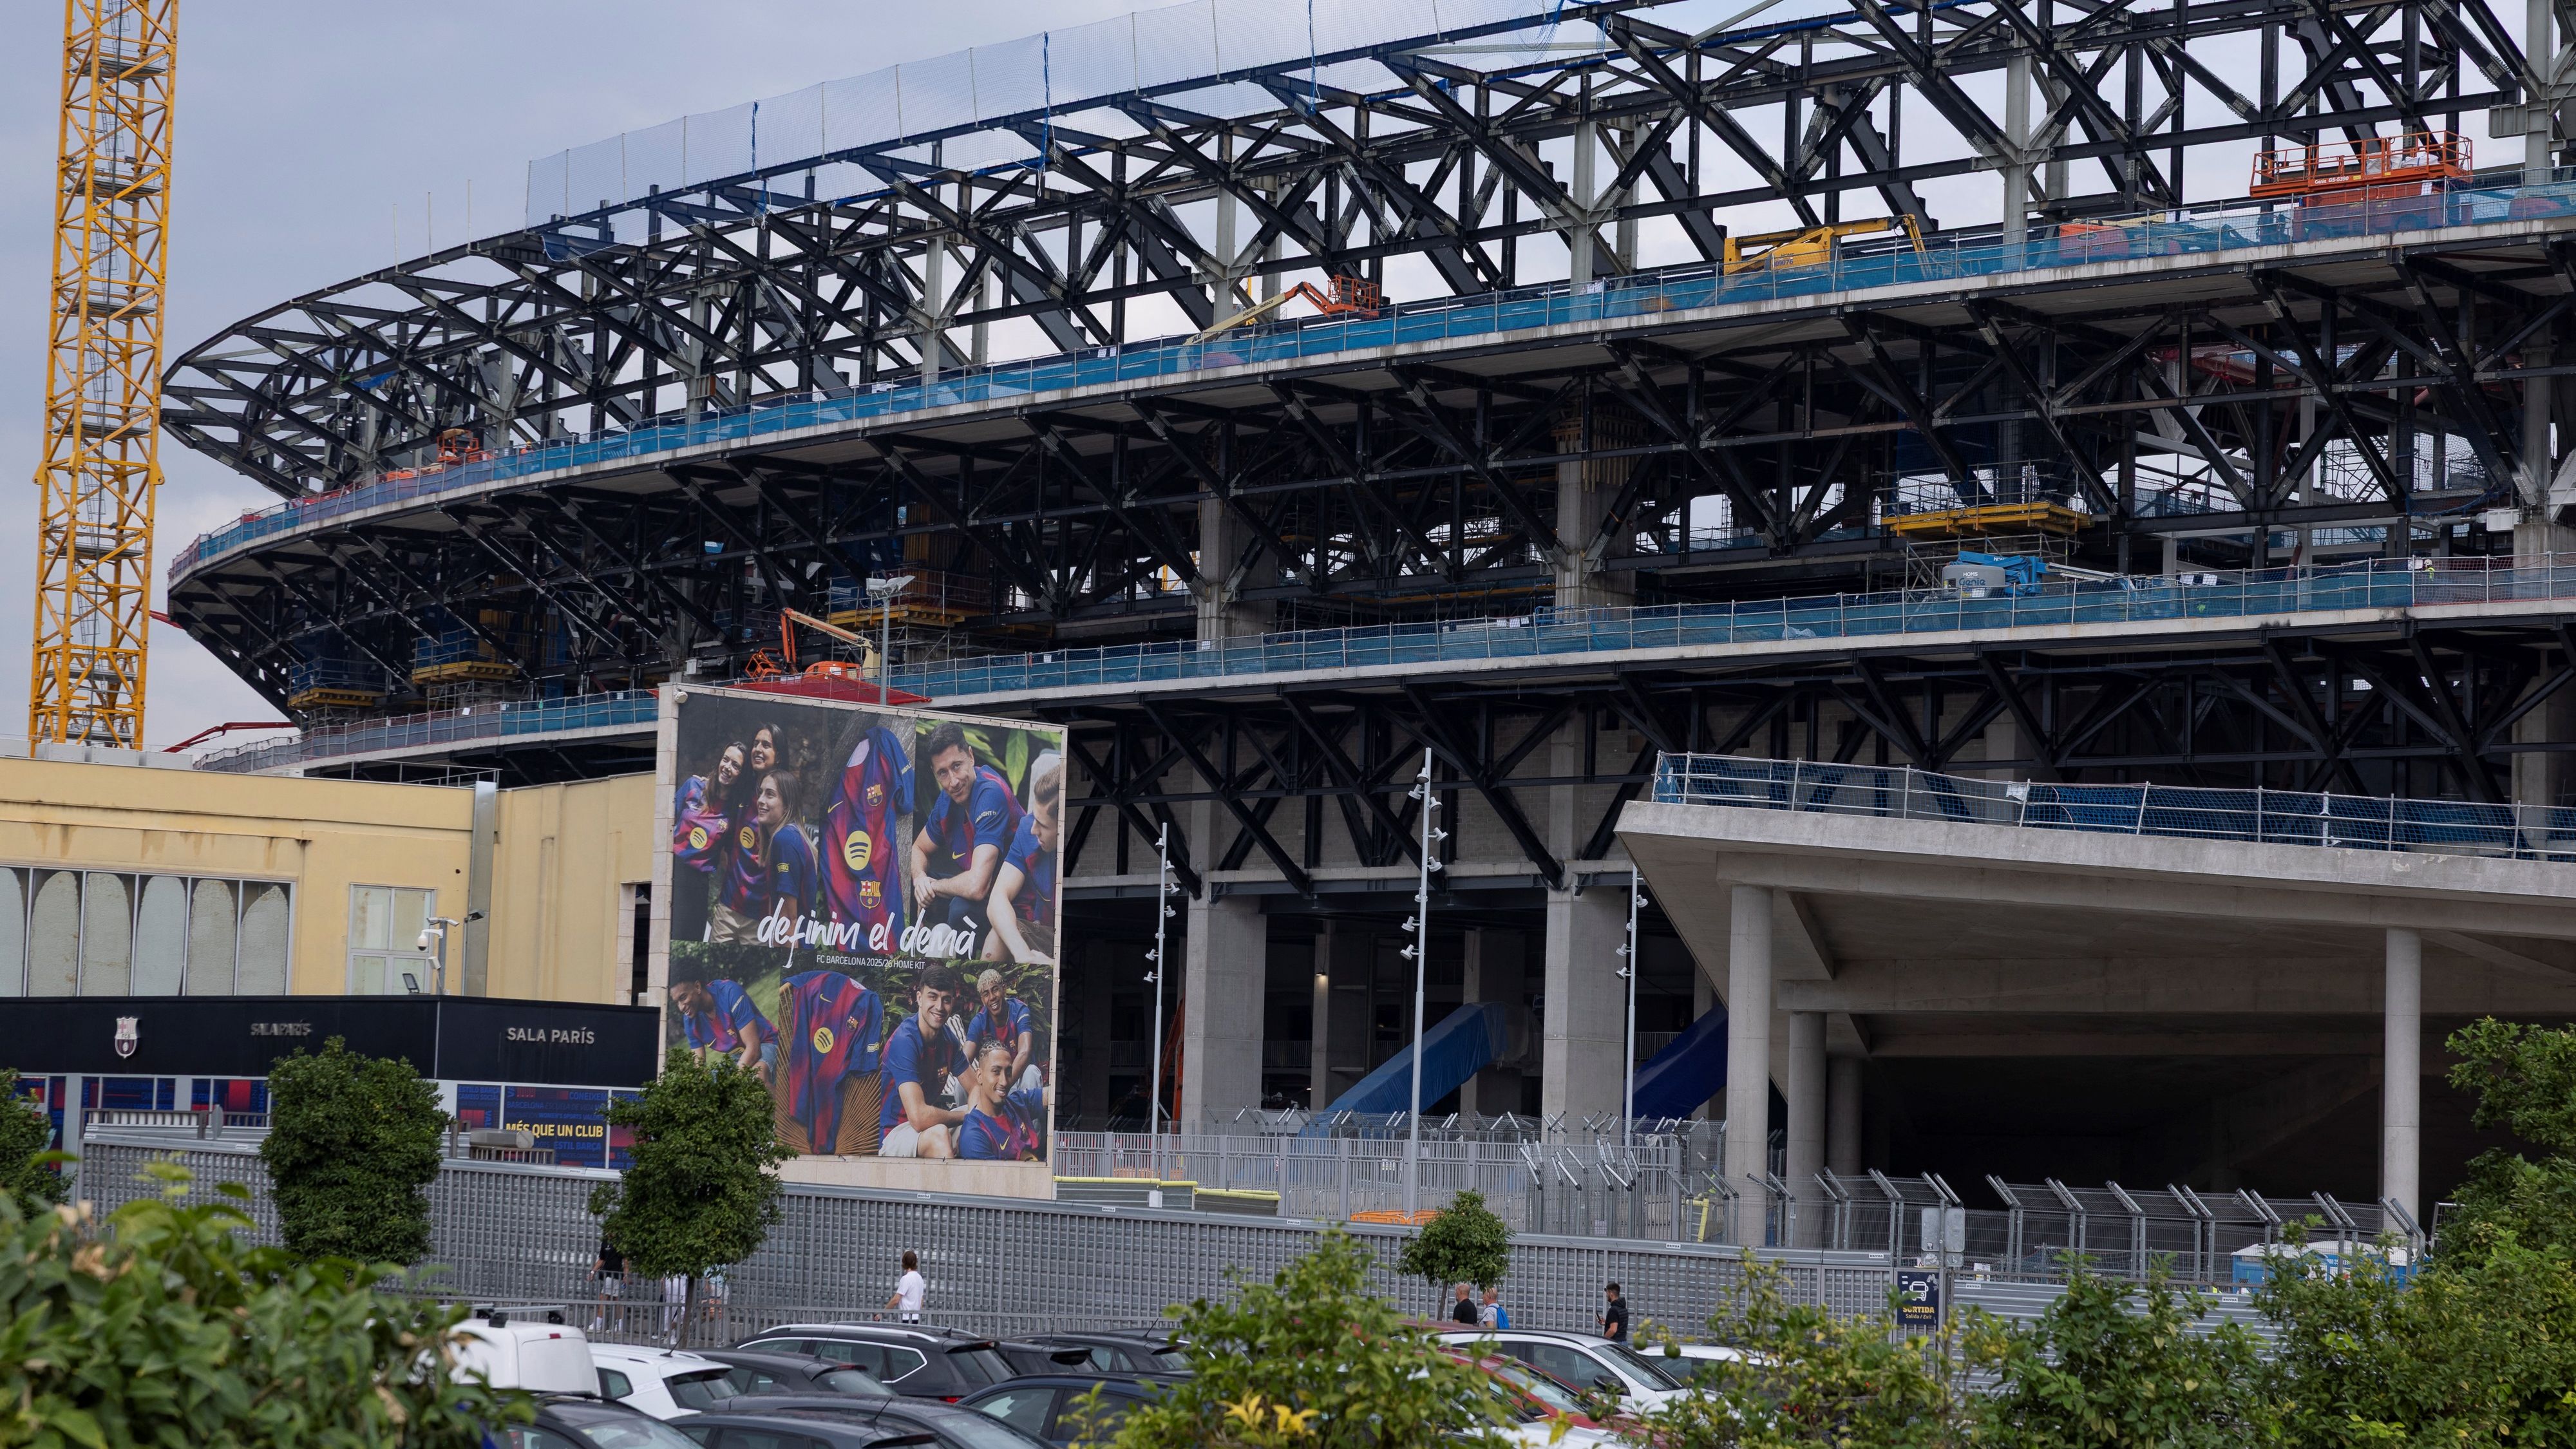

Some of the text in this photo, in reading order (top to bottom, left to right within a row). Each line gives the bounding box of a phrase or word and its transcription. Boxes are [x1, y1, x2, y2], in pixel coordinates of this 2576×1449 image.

[1959, 578, 1986, 586] Genie
[757, 897, 978, 968] definim el demà
[816, 954, 925, 970] FC BARCELONA 2025/26 HOME KIT
[507, 1027, 595, 1045] SALA PARÍS
[507, 1101, 544, 1109] BARCELONA
[532, 1124, 554, 1137] QUE
[556, 1125, 573, 1136] UN
[575, 1126, 603, 1137] CLUB
[576, 1142, 601, 1151] BARÇA
